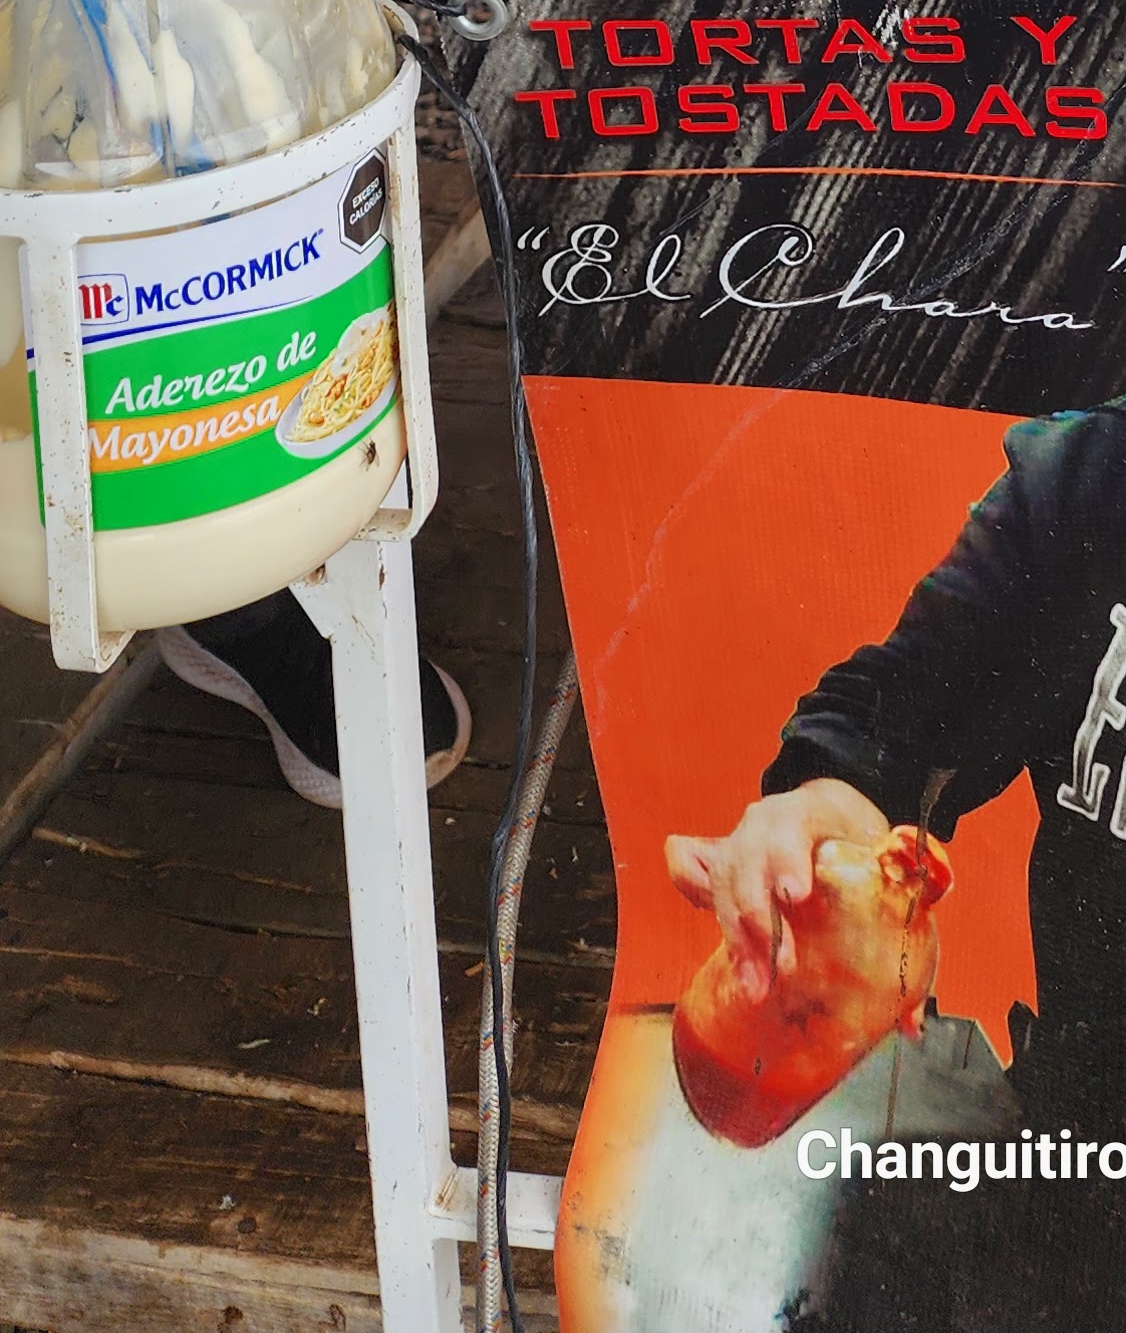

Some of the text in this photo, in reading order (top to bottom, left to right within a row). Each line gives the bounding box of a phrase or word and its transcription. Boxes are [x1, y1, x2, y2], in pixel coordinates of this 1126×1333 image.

[529, 15, 1077, 69] TORTAS Y
[514, 83, 1108, 140] TOSTADAS
[352, 176, 380, 209] EXCESO
[135, 231, 320, 315] McCORMICK
[105, 331, 317, 414] Aderezo de
[88, 395, 281, 464] Mayonesa
